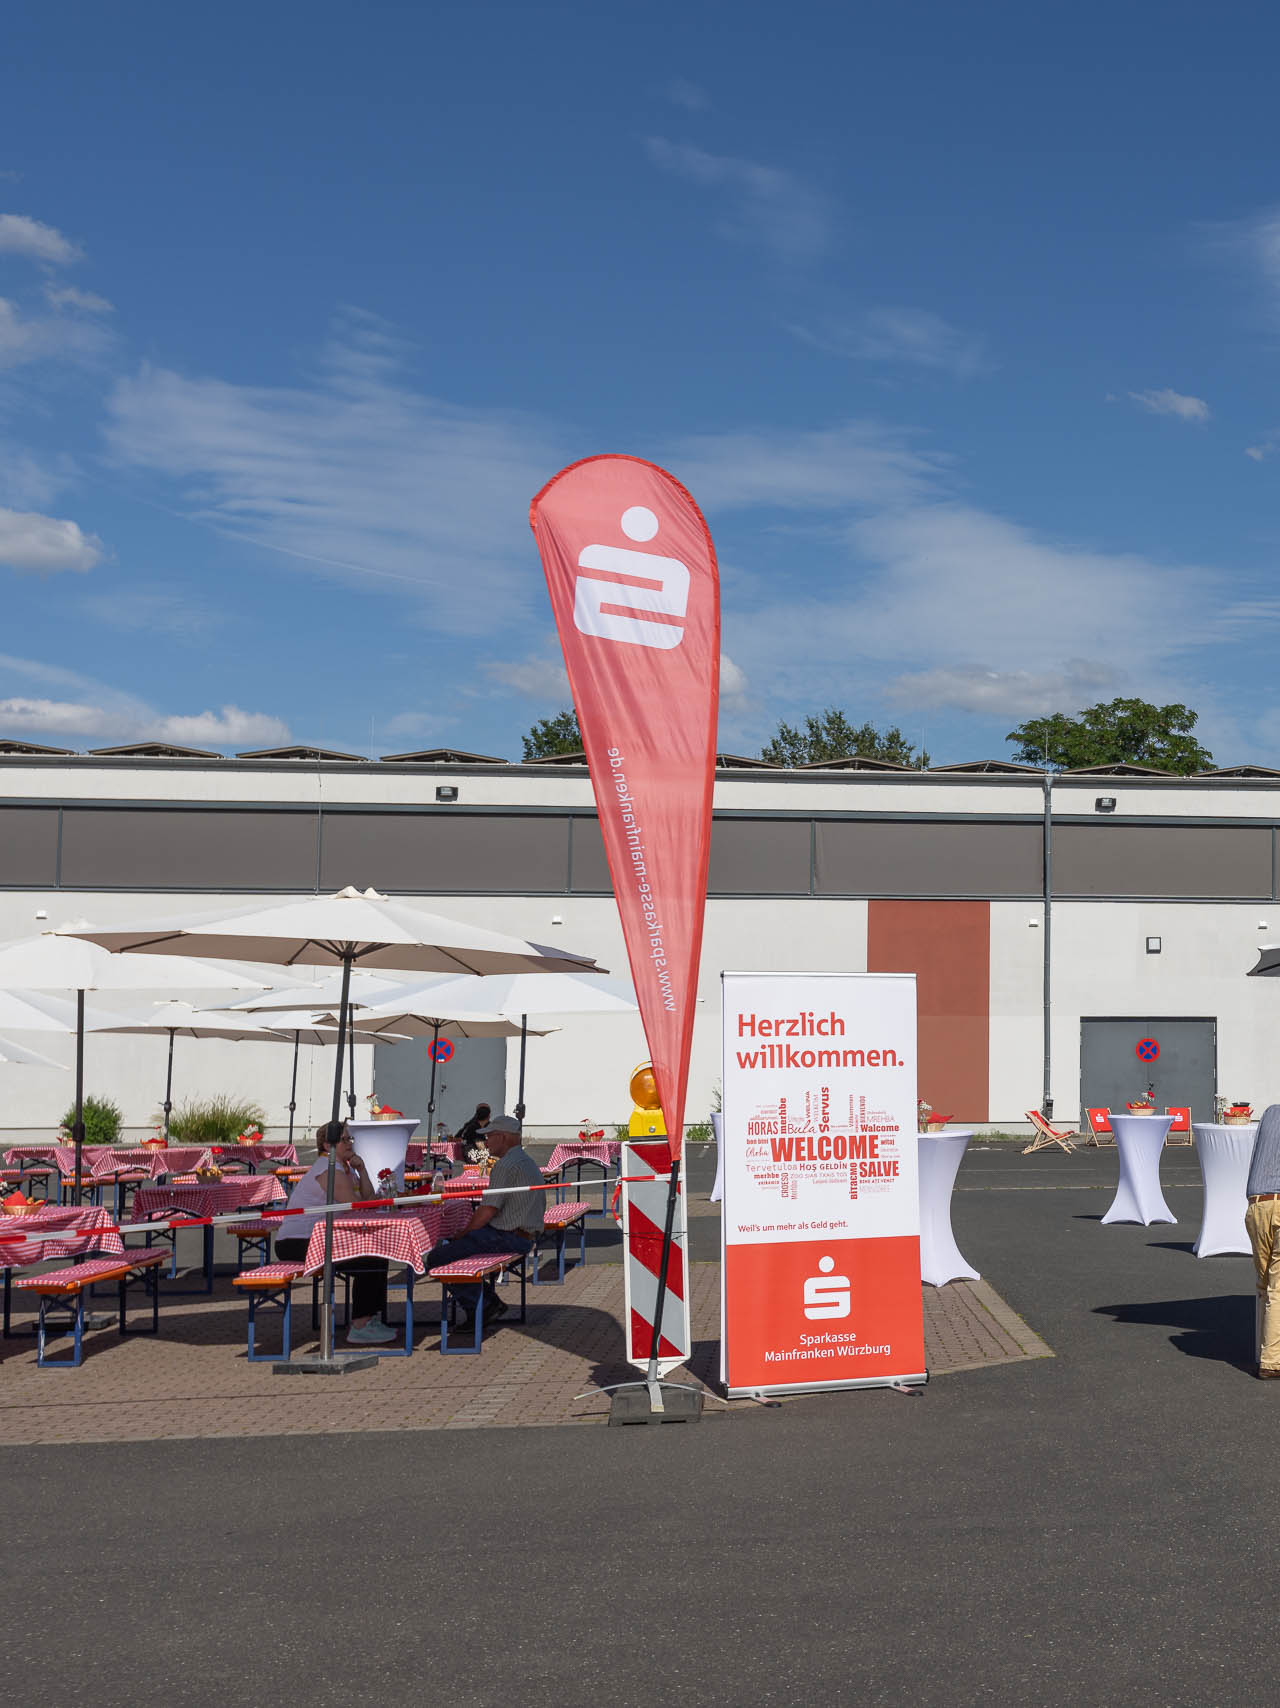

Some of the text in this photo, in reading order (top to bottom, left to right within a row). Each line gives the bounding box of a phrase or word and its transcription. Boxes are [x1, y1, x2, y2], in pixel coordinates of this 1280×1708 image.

[737, 1012, 846, 1037] Herzlich
[736, 1044, 905, 1069] willkommen.
[818, 1086, 830, 1134] Servus
[748, 1121, 778, 1136] HORAS
[788, 1120, 817, 1134] Bula
[770, 1135, 879, 1162] WELCOME
[746, 1163, 798, 1173] Tervetuloa
[859, 1161, 900, 1178] SALVE
[780, 1172, 789, 1198] CROESO
[738, 1224, 761, 1233] Weil's
[776, 1222, 796, 1231] mehr
[798, 1222, 809, 1230] als
[810, 1221, 828, 1230] Geld
[829, 1220, 848, 1231] geht.
[799, 1332, 857, 1346] Sparkasse
[764, 1343, 891, 1363] Mainfranken Würzburg
